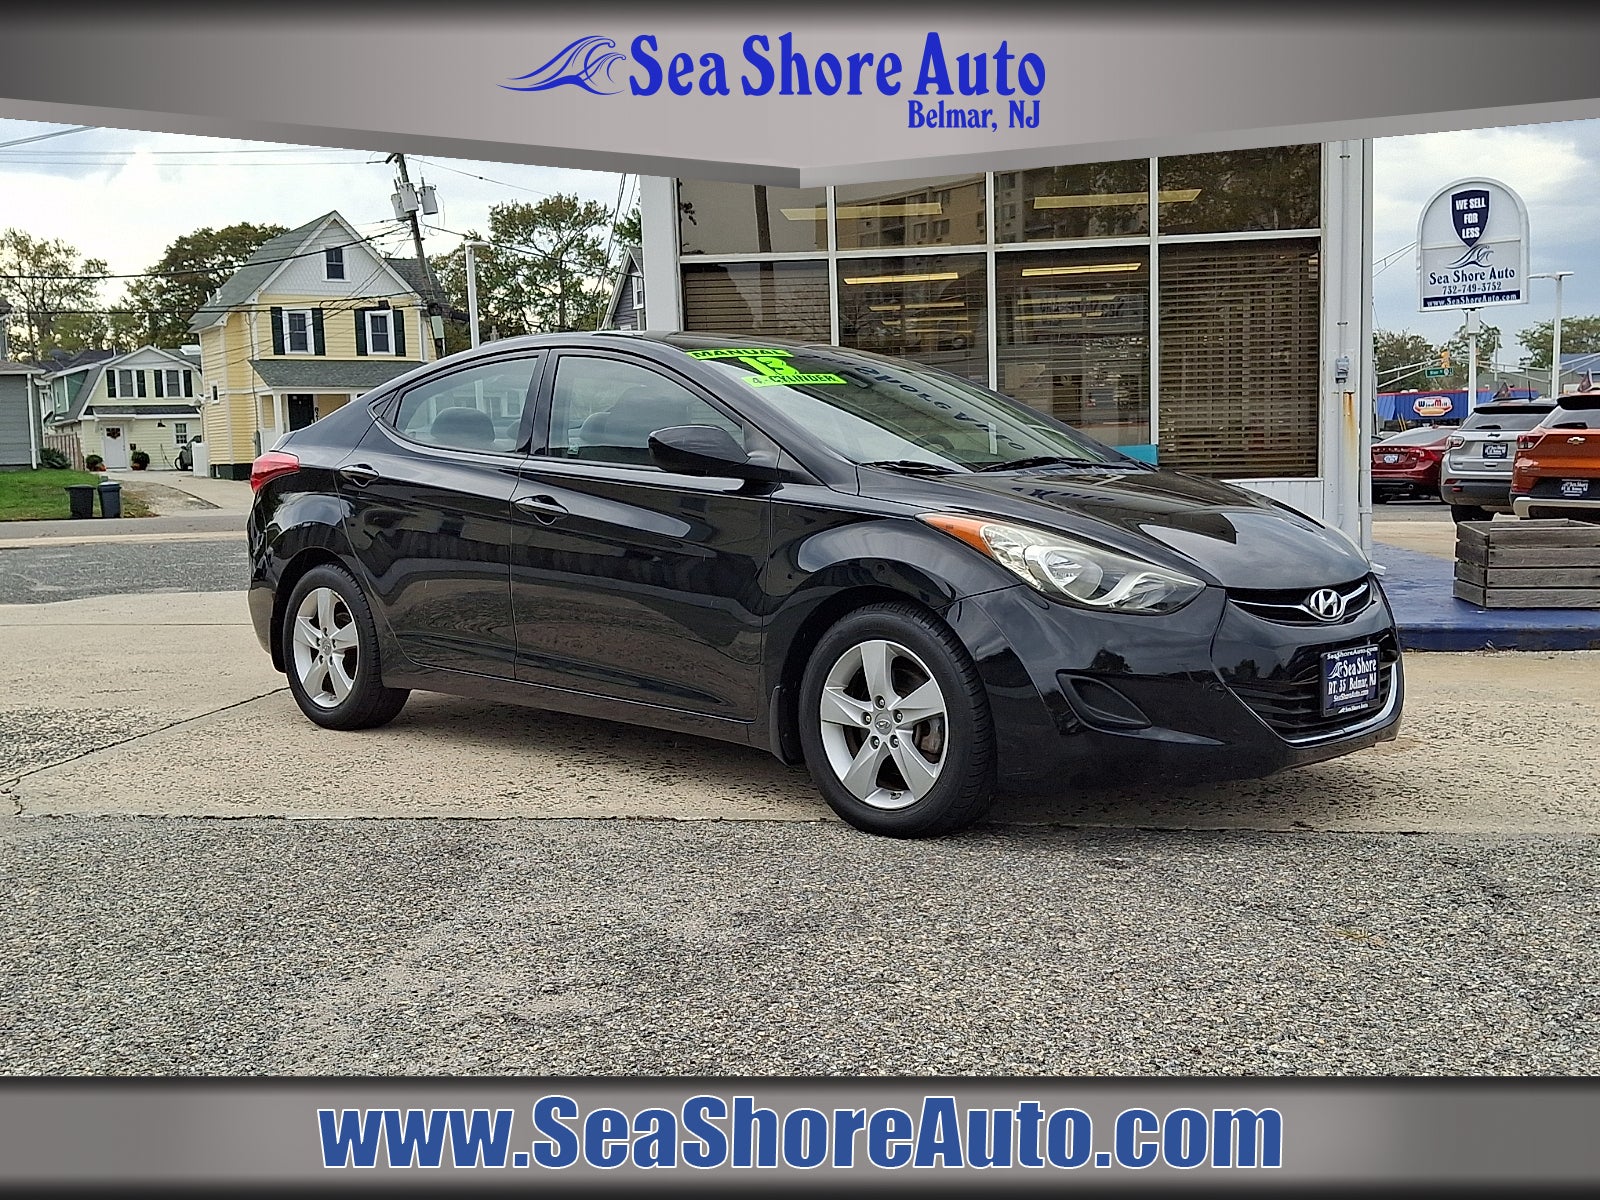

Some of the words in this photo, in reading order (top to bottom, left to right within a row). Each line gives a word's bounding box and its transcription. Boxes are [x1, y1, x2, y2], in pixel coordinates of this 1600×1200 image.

[1455, 199, 1469, 210] WE
[1469, 197, 1486, 209] SELL
[1464, 213, 1478, 224] FOR
[1462, 227, 1480, 239] LESS
[1429, 272, 1449, 285] Sea
[1453, 270, 1486, 283] Shore
[1489, 267, 1515, 280] Auto
[1442, 282, 1502, 295] 732-749-3752
[1426, 294, 1517, 307] www.SeaShoreAuto.com
[691, 349, 784, 358] MANUAL
[1343, 659, 1357, 678] Sea
[1357, 656, 1377, 675] Shore
[1369, 672, 1377, 687] NJ
